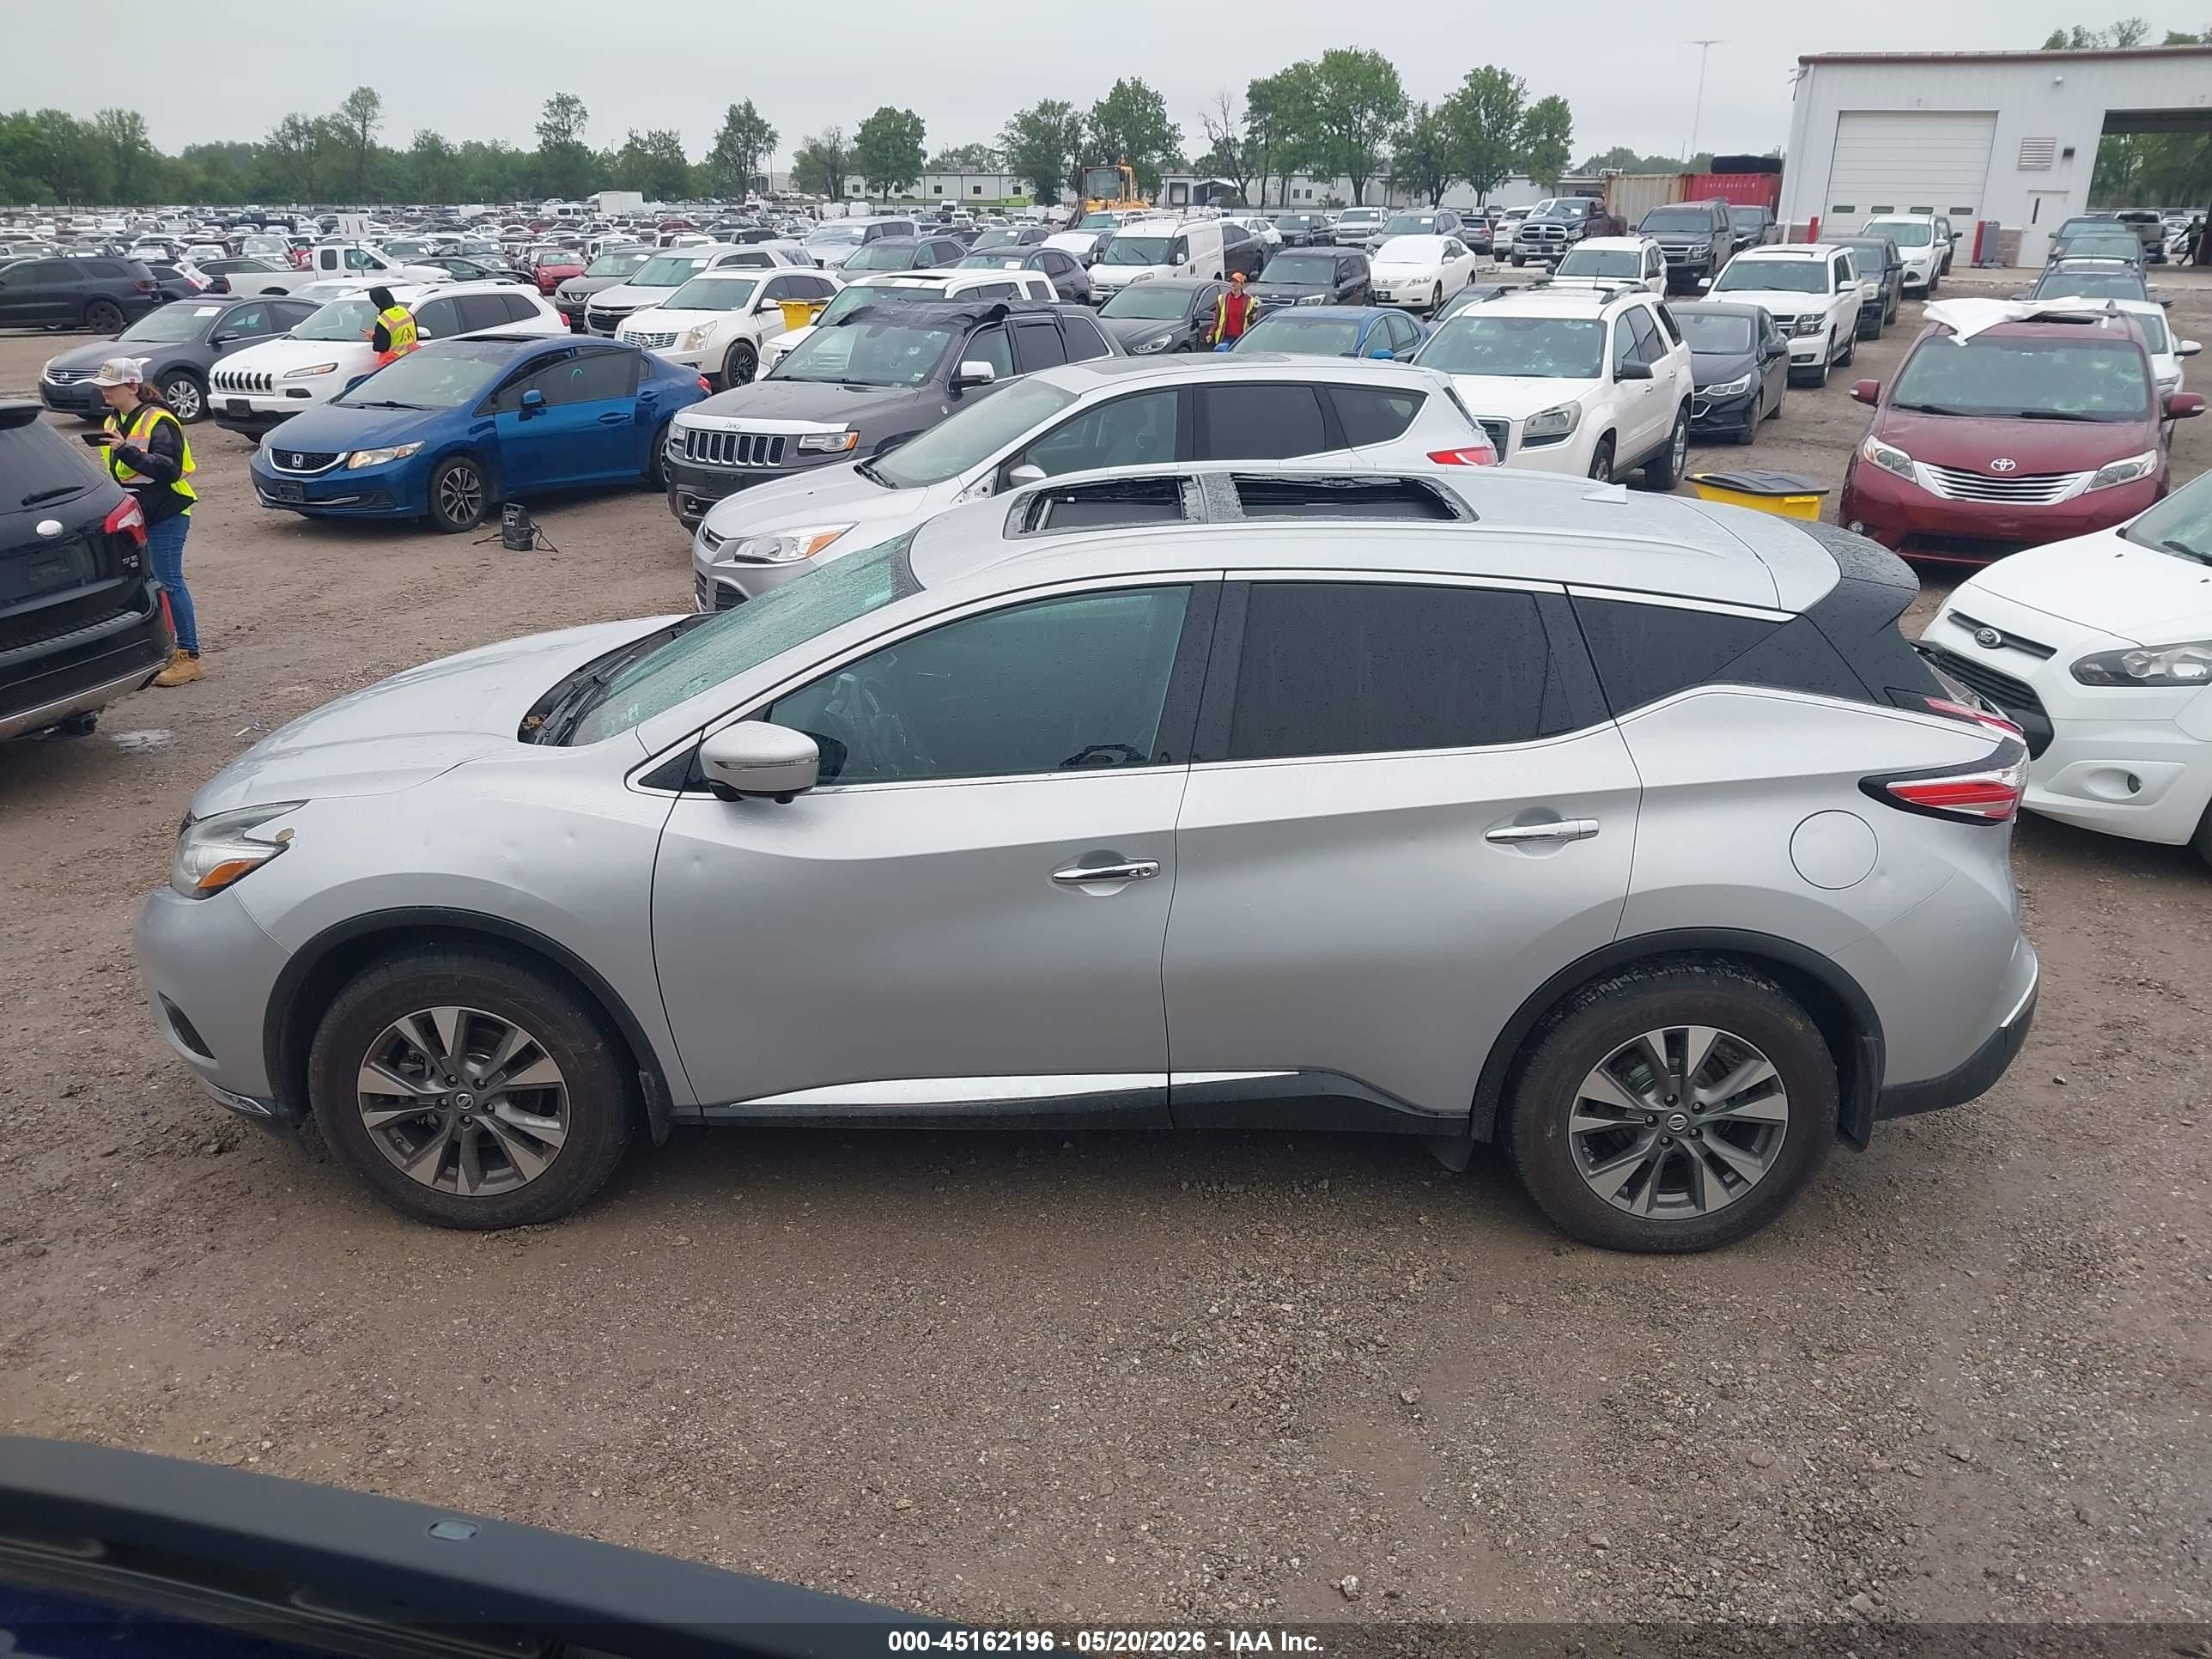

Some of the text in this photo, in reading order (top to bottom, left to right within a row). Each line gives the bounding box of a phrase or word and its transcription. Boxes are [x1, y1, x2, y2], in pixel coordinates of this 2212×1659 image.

[345, 219, 365, 234] J K
[722, 419, 742, 430] Jeep
